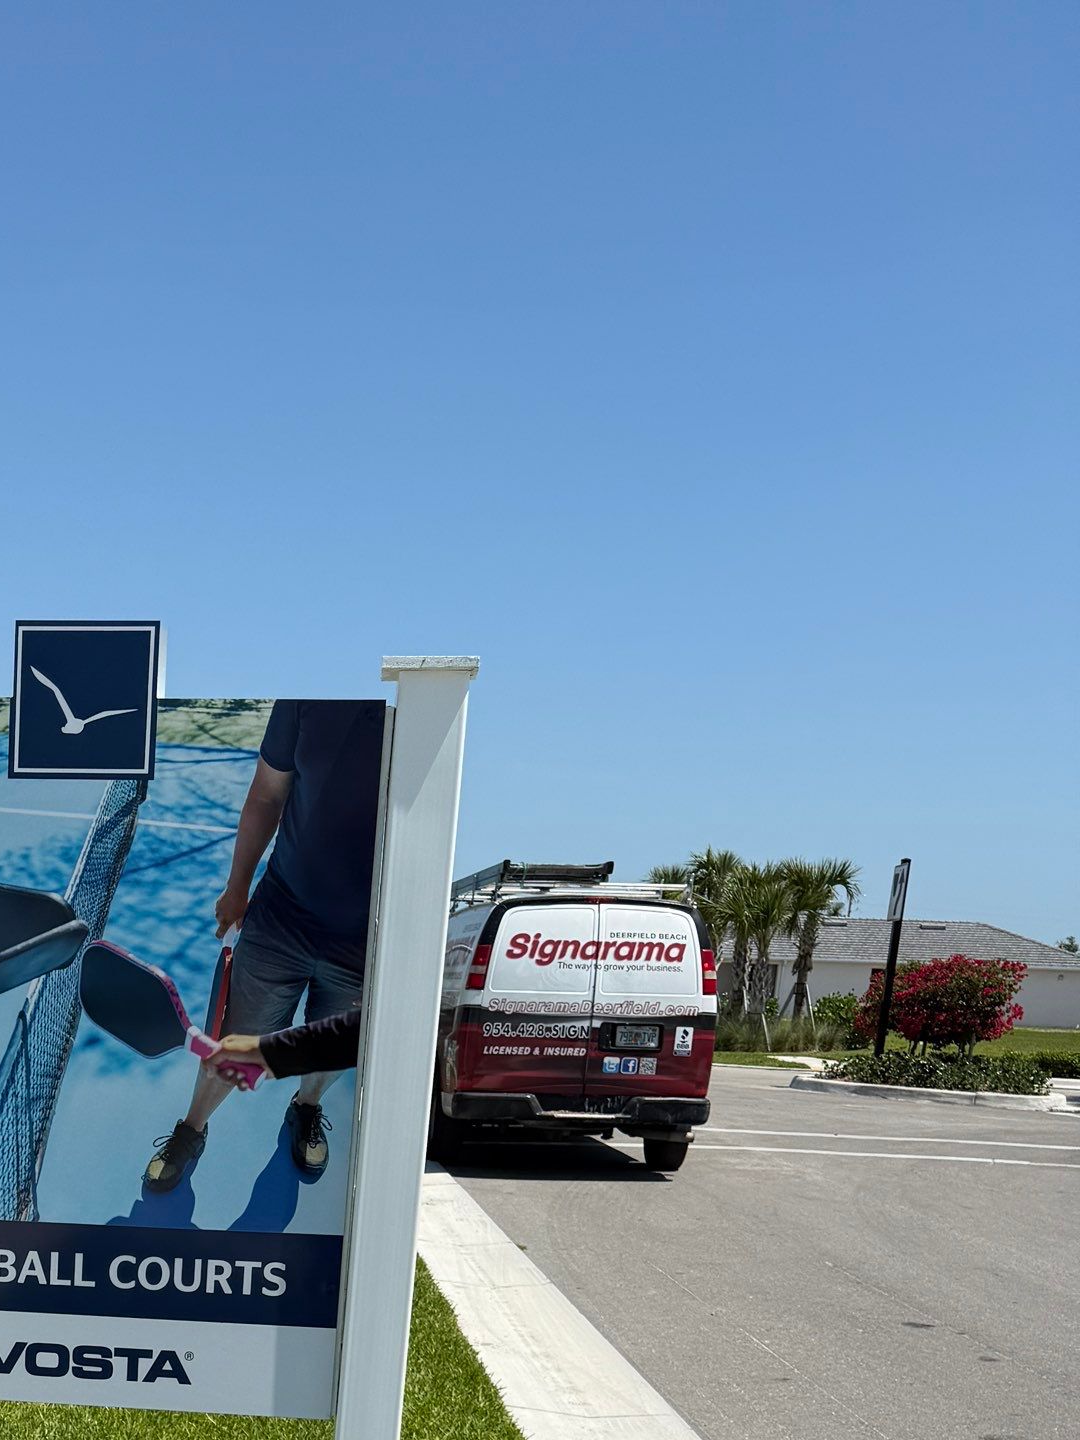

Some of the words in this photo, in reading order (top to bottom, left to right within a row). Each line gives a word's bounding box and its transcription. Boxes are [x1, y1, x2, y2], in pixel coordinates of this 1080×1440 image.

[609, 932, 656, 940] DEERFIELD
[506, 933, 686, 966] Signarama
[558, 961, 573, 970] The
[575, 963, 592, 972] way
[603, 963, 625, 973] grow
[626, 964, 645, 973] your
[488, 998, 699, 1016] SignaramaDeerfield.com
[483, 1022, 590, 1039] 954.428.SIGN
[483, 1046, 531, 1055] LICENSED
[533, 1047, 541, 1056] &
[543, 1047, 587, 1057] INSURED
[108, 1254, 287, 1297] COURTS
